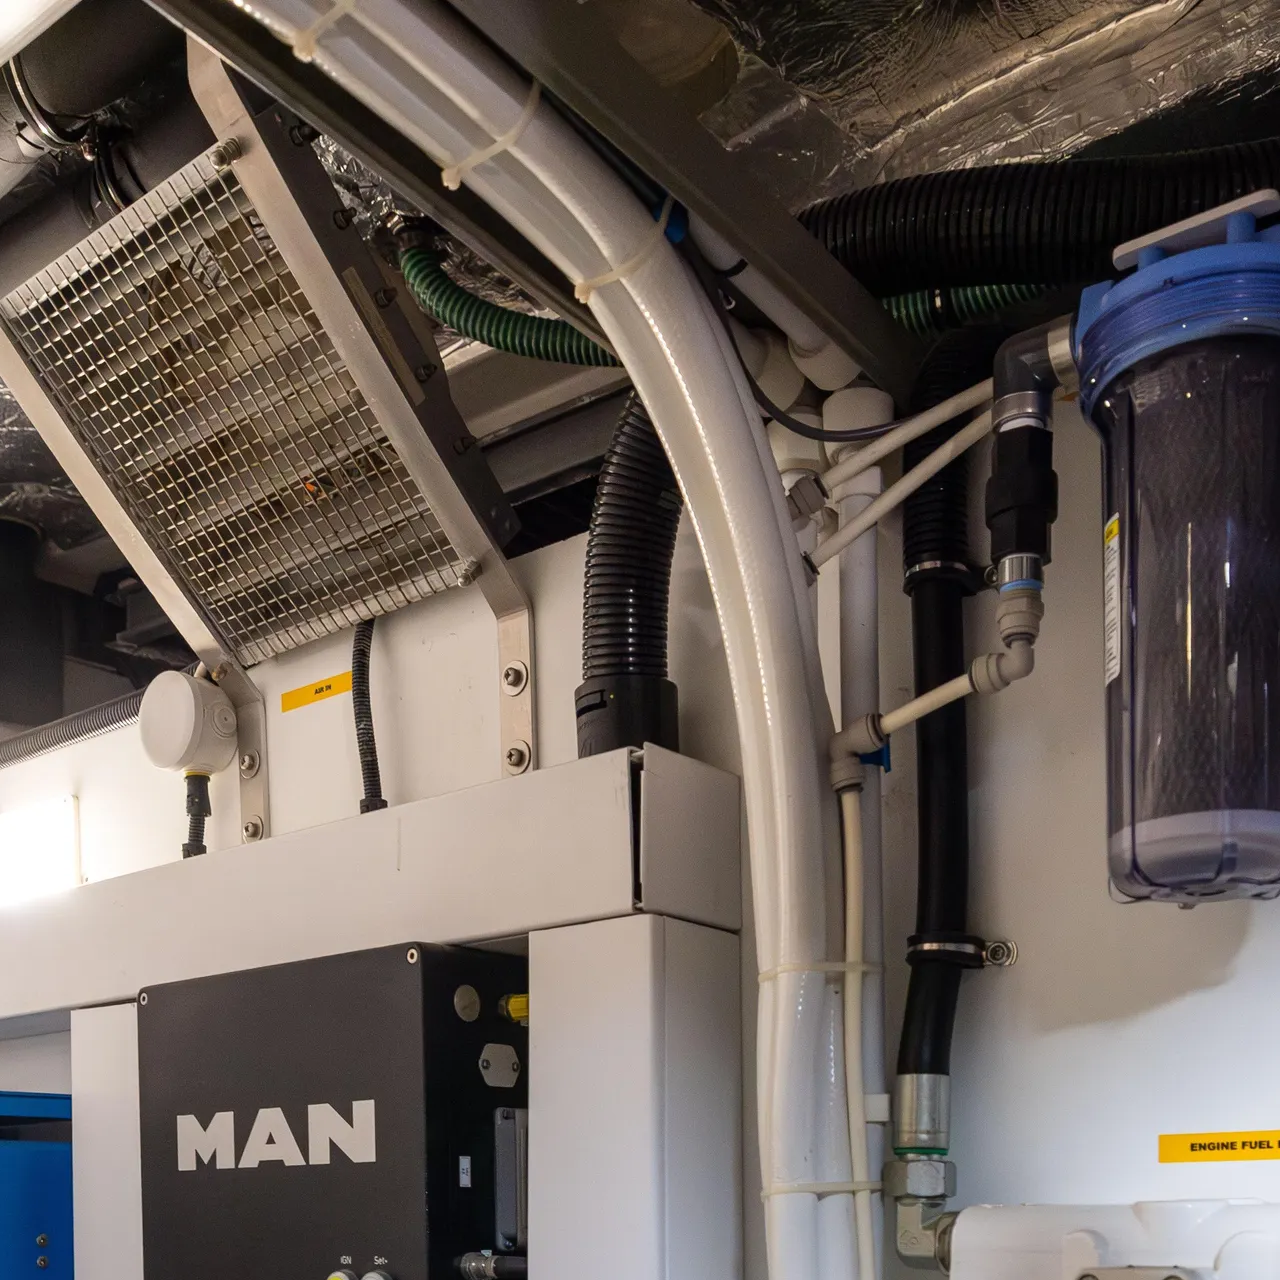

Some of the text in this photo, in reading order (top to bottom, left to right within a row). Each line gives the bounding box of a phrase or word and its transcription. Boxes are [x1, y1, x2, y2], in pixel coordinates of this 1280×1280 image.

[176, 1099, 376, 1171] MAN
[1190, 1141, 1237, 1152] ENGINE
[1241, 1139, 1273, 1150] FUEL
[340, 1256, 352, 1264] IGN
